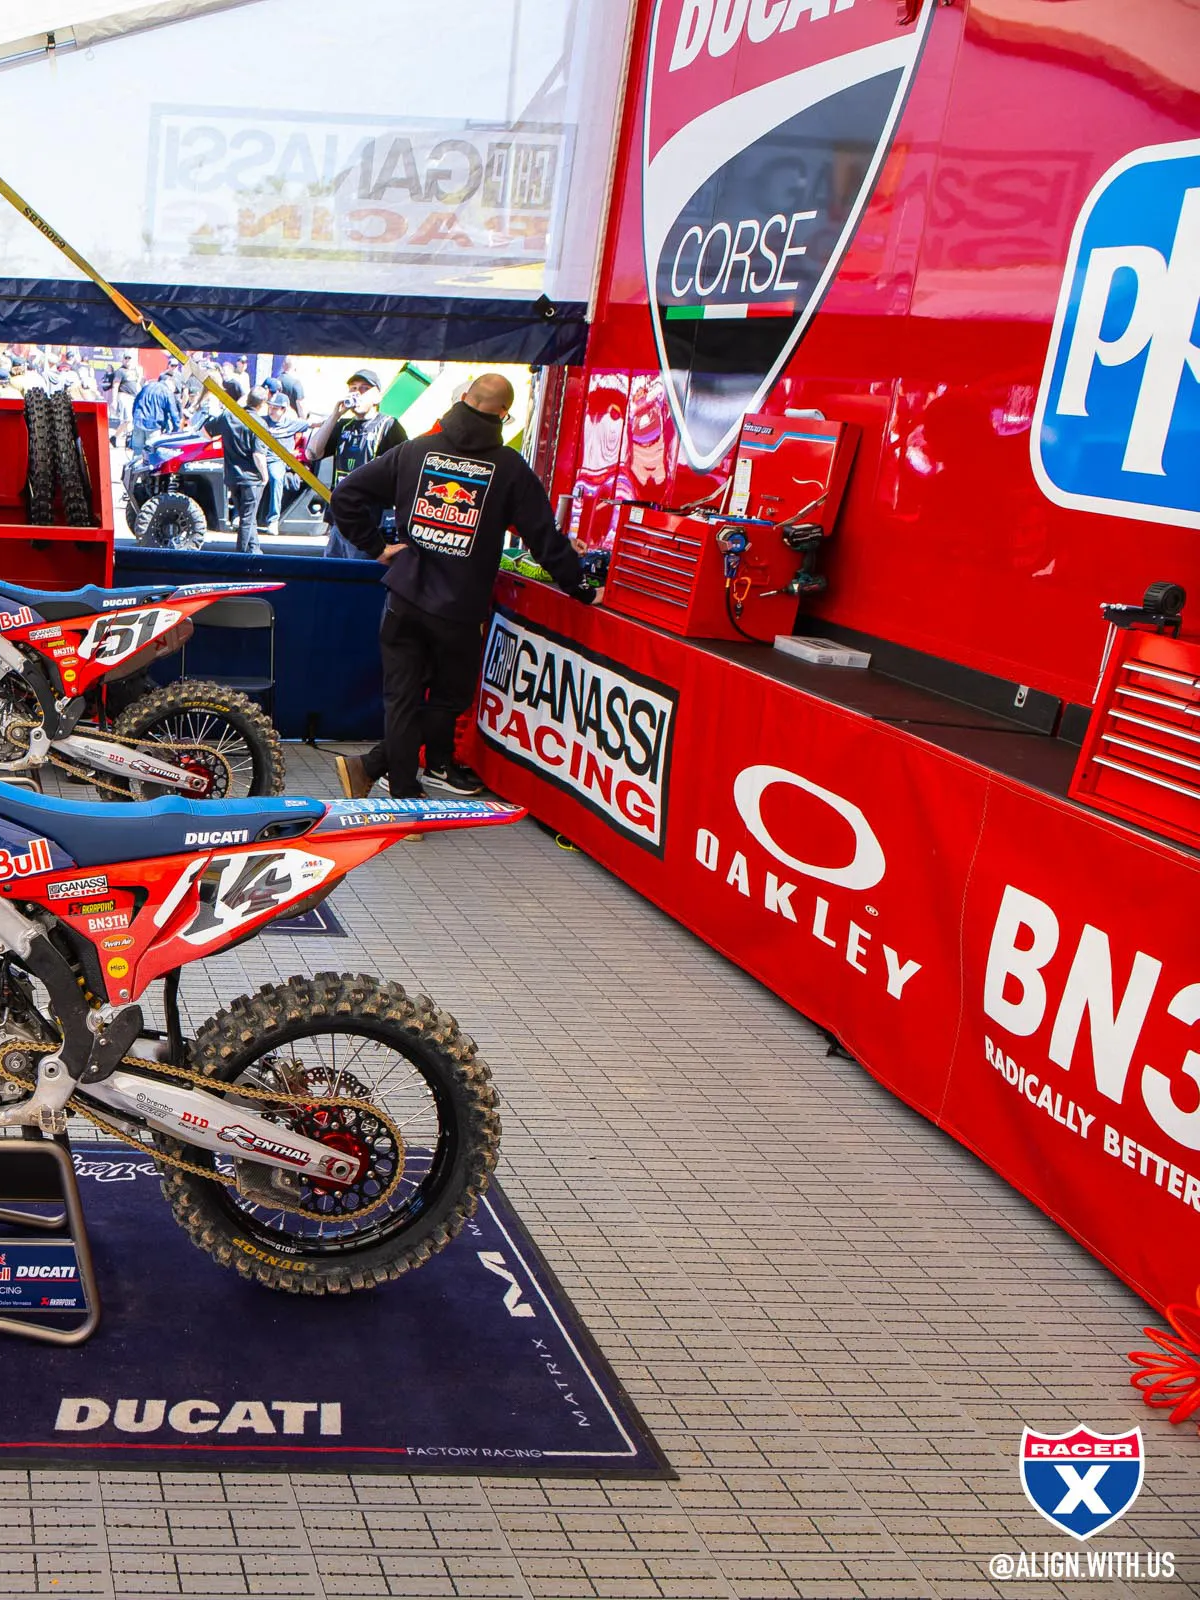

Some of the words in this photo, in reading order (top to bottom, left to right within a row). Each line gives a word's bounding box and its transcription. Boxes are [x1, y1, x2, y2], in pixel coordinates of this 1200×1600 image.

[670, 210, 817, 298] CORSE
[426, 456, 441, 471] Troy
[440, 459, 457, 471] Lee
[456, 461, 492, 477] Designs
[415, 498, 447, 521] Red
[445, 505, 479, 528] Bull
[411, 524, 472, 549] DUCATI
[437, 546, 467, 557] RACING
[103, 598, 137, 608] DUCATI
[0, 605, 34, 630] Bull
[91, 610, 161, 659] 51
[53, 646, 75, 657] BN3TH
[487, 630, 516, 690] CHIP
[512, 639, 666, 784] GANASSI
[109, 753, 125, 764] DID
[479, 691, 656, 834] RACING
[422, 811, 495, 820] DUNLOP
[185, 829, 248, 845] DUCATI
[49, 887, 108, 899] RACING
[60, 877, 106, 892] GANASSI
[184, 852, 292, 937] 14
[88, 914, 129, 930] BN3TH
[695, 828, 923, 1000] OAKLEY
[103, 940, 120, 948] Twin
[121, 938, 132, 946] Air
[146, 1097, 173, 1113] brembo
[181, 1111, 209, 1128] DID
[984, 1035, 1096, 1139] RADICALLY
[1103, 1124, 1200, 1213] BETTER
[218, 1125, 312, 1164] RENTHAL
[232, 1238, 305, 1271] DUNLOP
[15, 1265, 76, 1279] DUCATI
[532, 1338, 591, 1427] MATRIX
[54, 1397, 342, 1435] DUCATI
[406, 1446, 478, 1459] FACTORY
[480, 1447, 542, 1459] RACING
